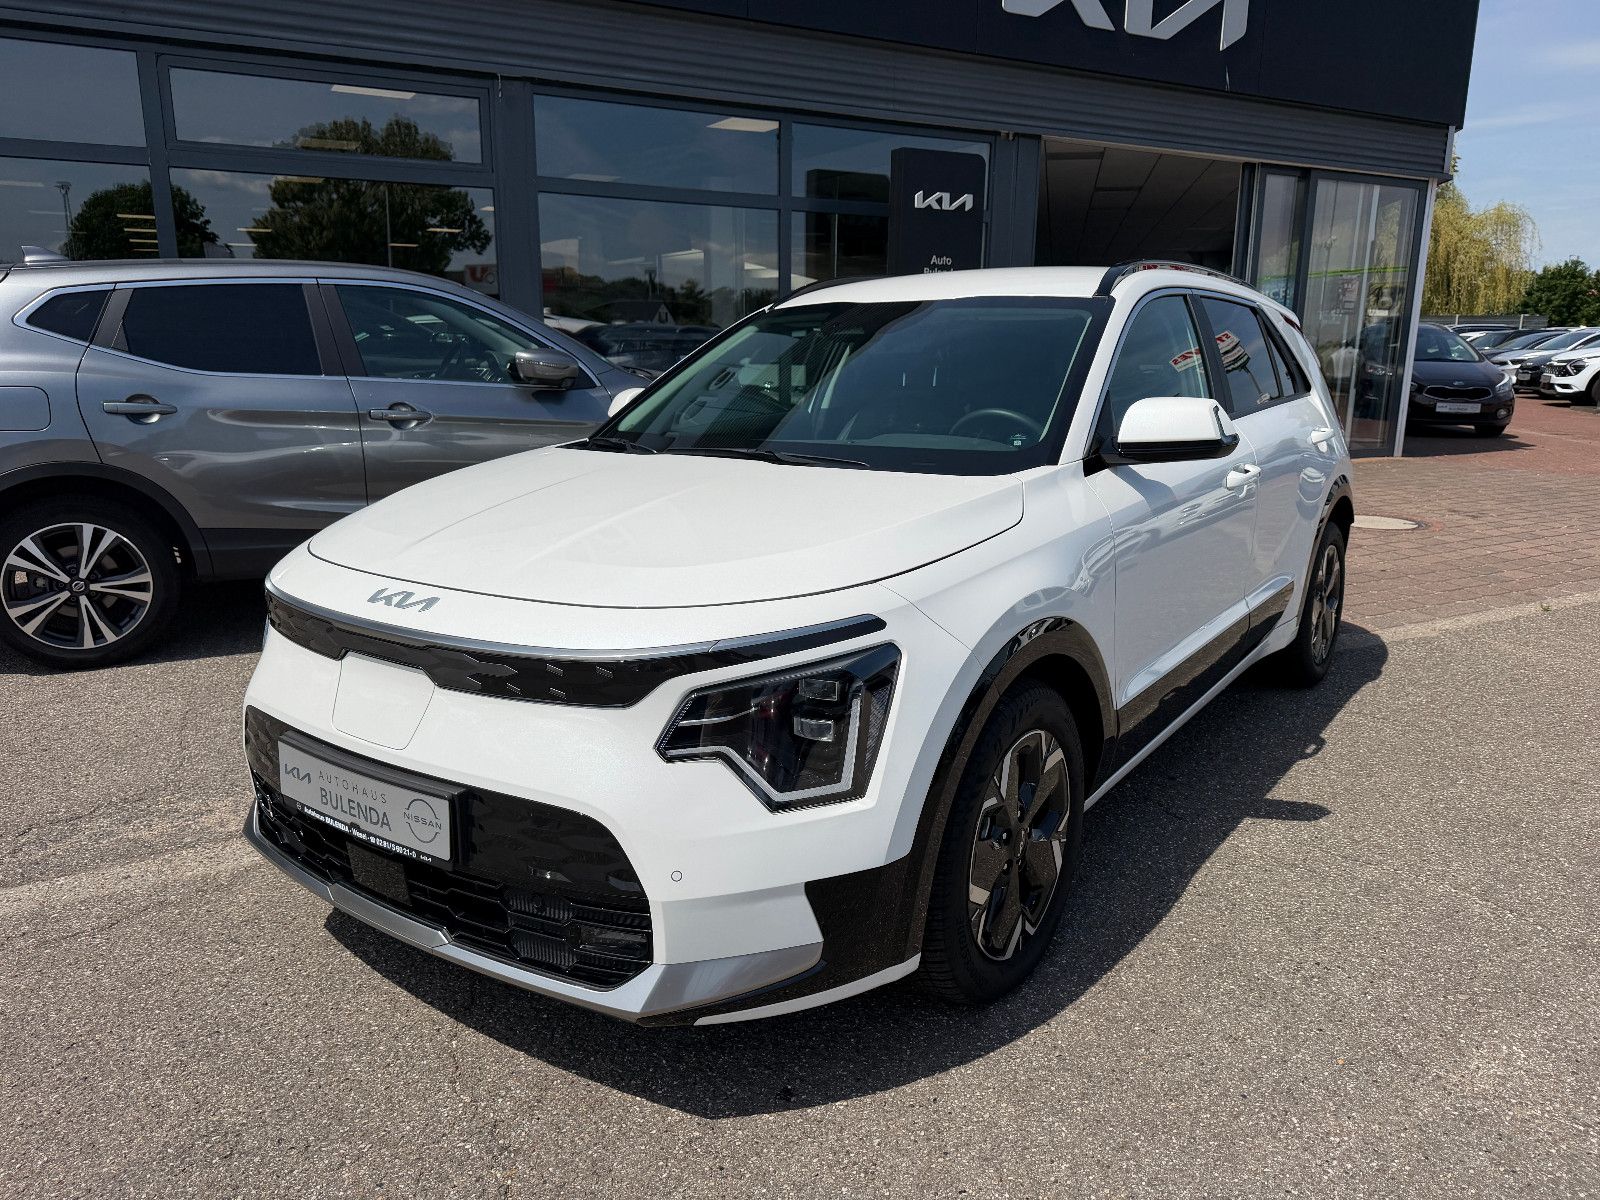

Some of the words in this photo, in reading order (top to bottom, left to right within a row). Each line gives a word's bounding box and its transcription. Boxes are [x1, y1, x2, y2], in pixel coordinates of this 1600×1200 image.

[914, 190, 974, 212] KIA
[930, 254, 953, 266] Auto
[367, 587, 441, 613] KIA
[284, 763, 312, 784] KIA
[318, 770, 387, 804] AUTOHAUS
[319, 786, 392, 832] BULENDA
[325, 816, 349, 833] BULENDA
[351, 827, 368, 841] Wesel
[403, 811, 442, 831] NISSAN
